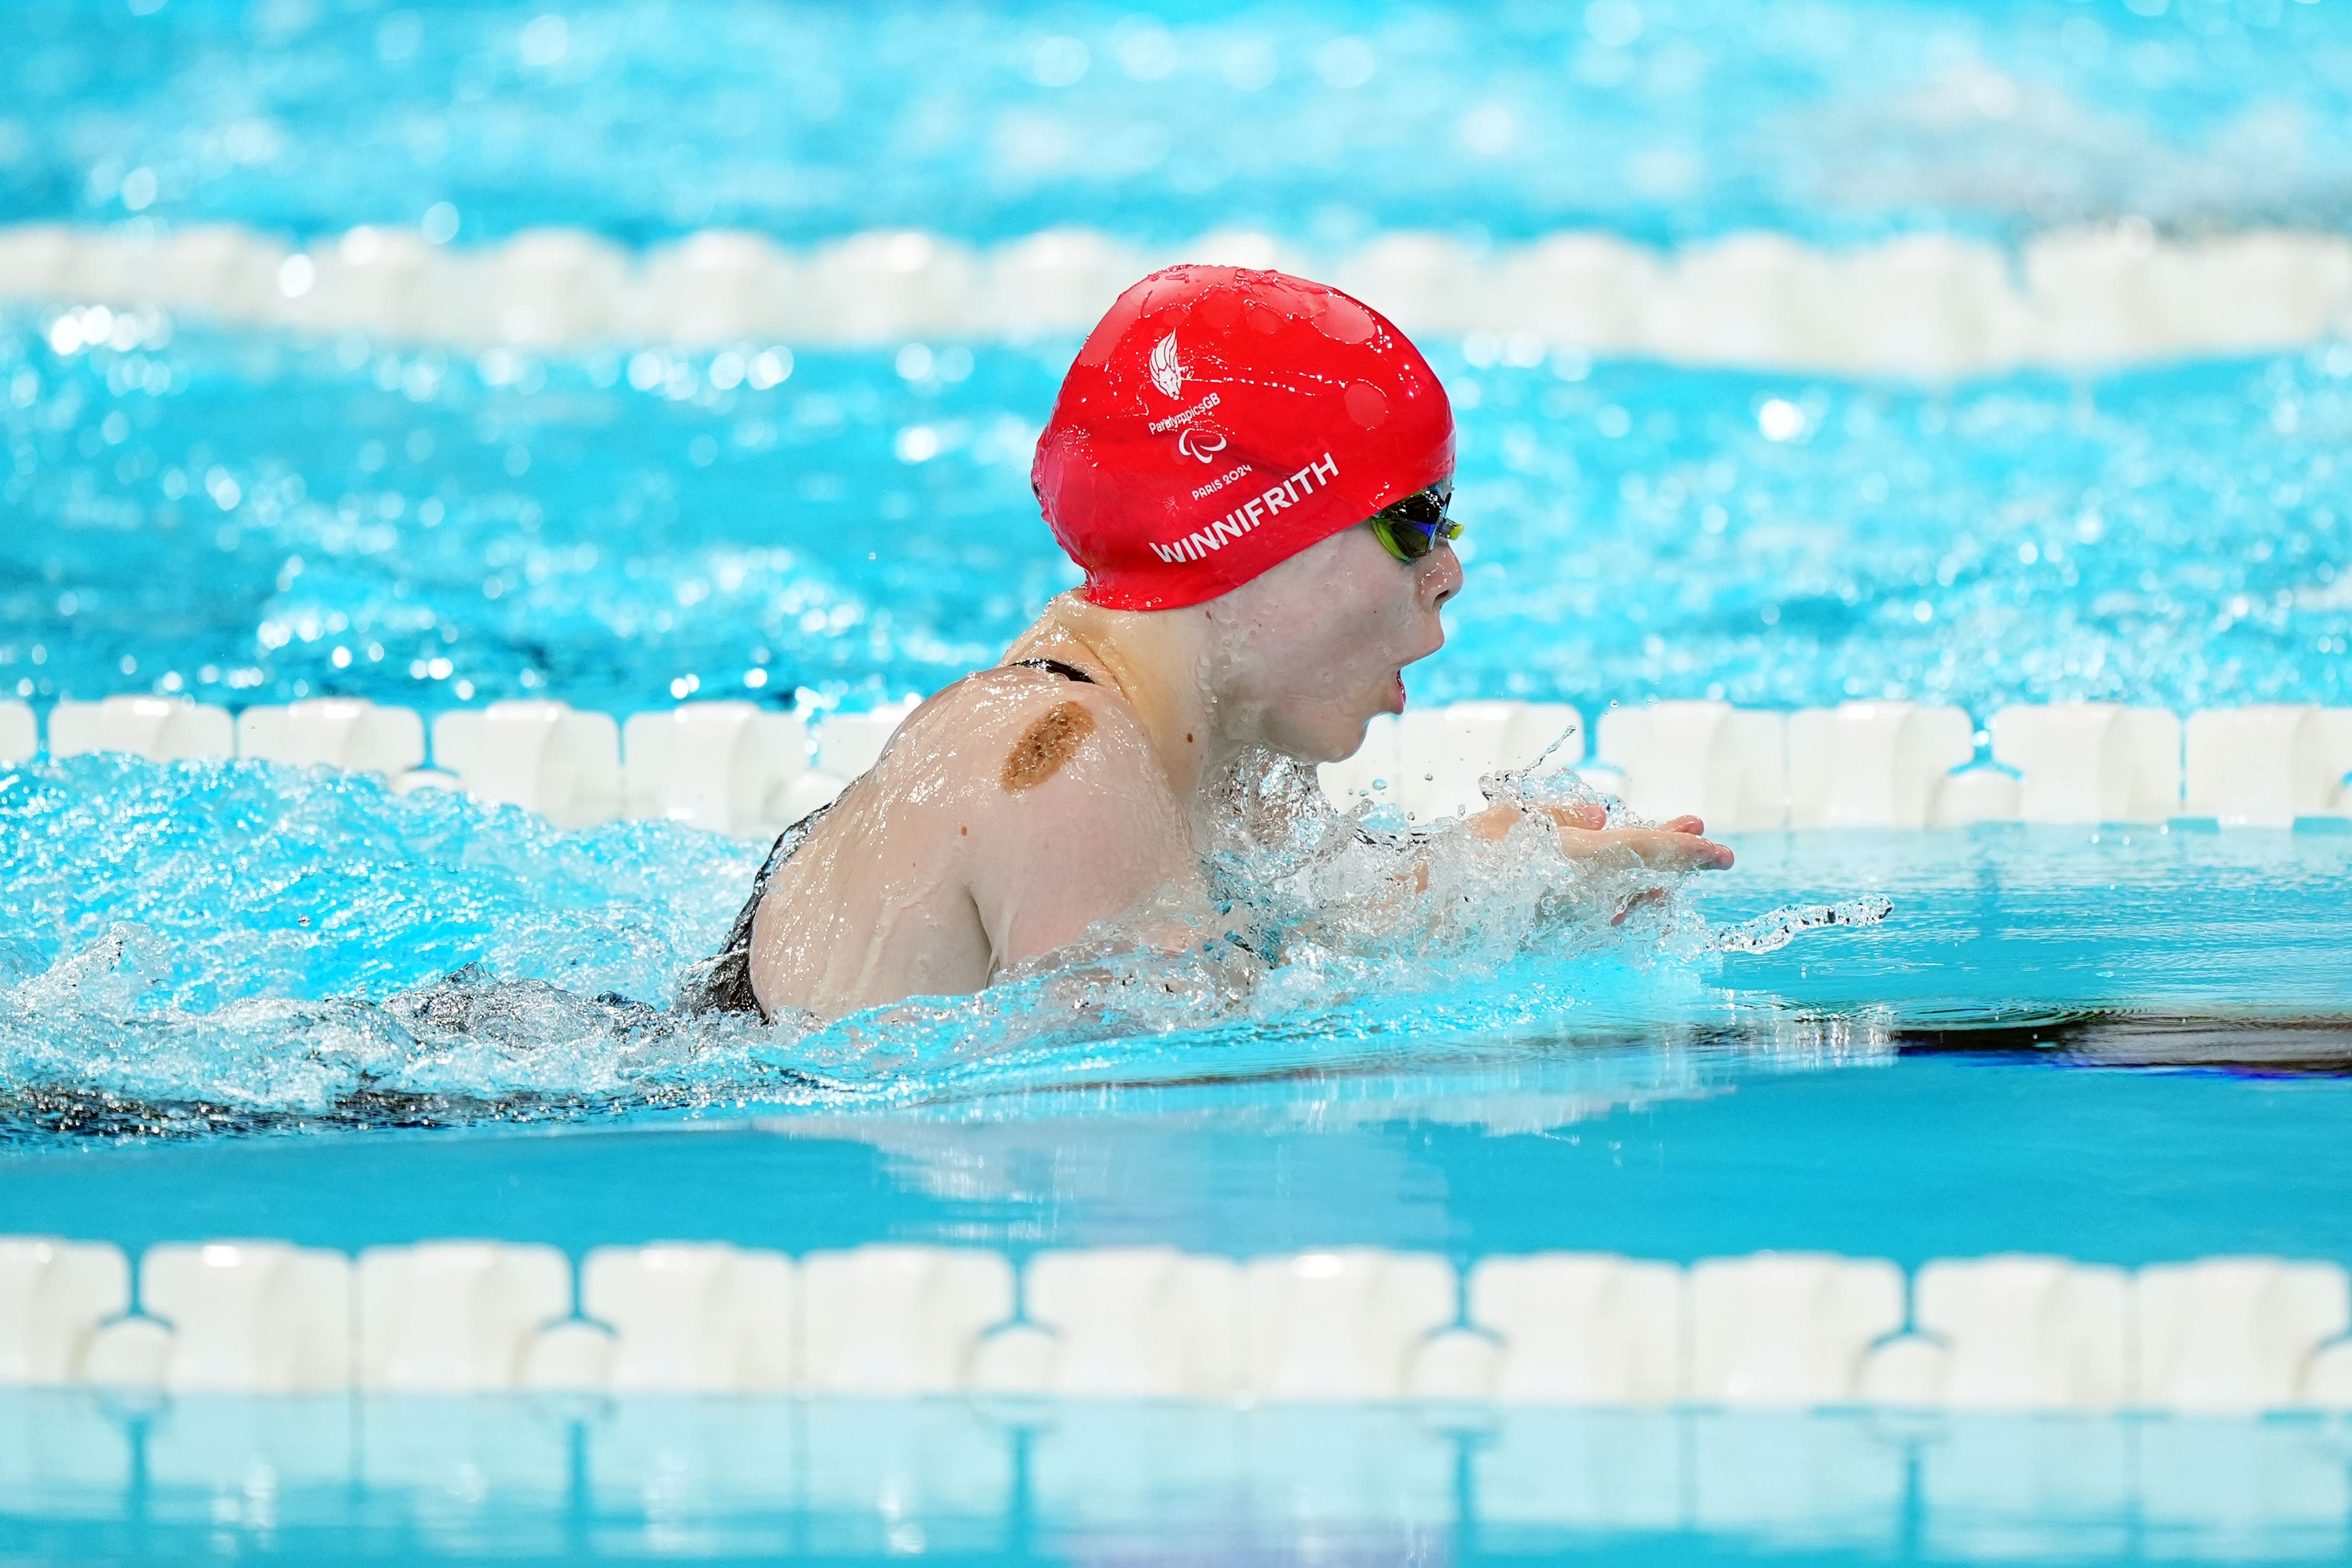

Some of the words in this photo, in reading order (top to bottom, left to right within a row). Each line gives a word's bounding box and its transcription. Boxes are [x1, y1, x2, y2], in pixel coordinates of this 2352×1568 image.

[1148, 392, 1220, 435] ParalympicsGB
[1191, 479, 1223, 501] PARIS
[1222, 464, 1253, 485] 2024
[1149, 452, 1339, 563] WINNIFRITH
